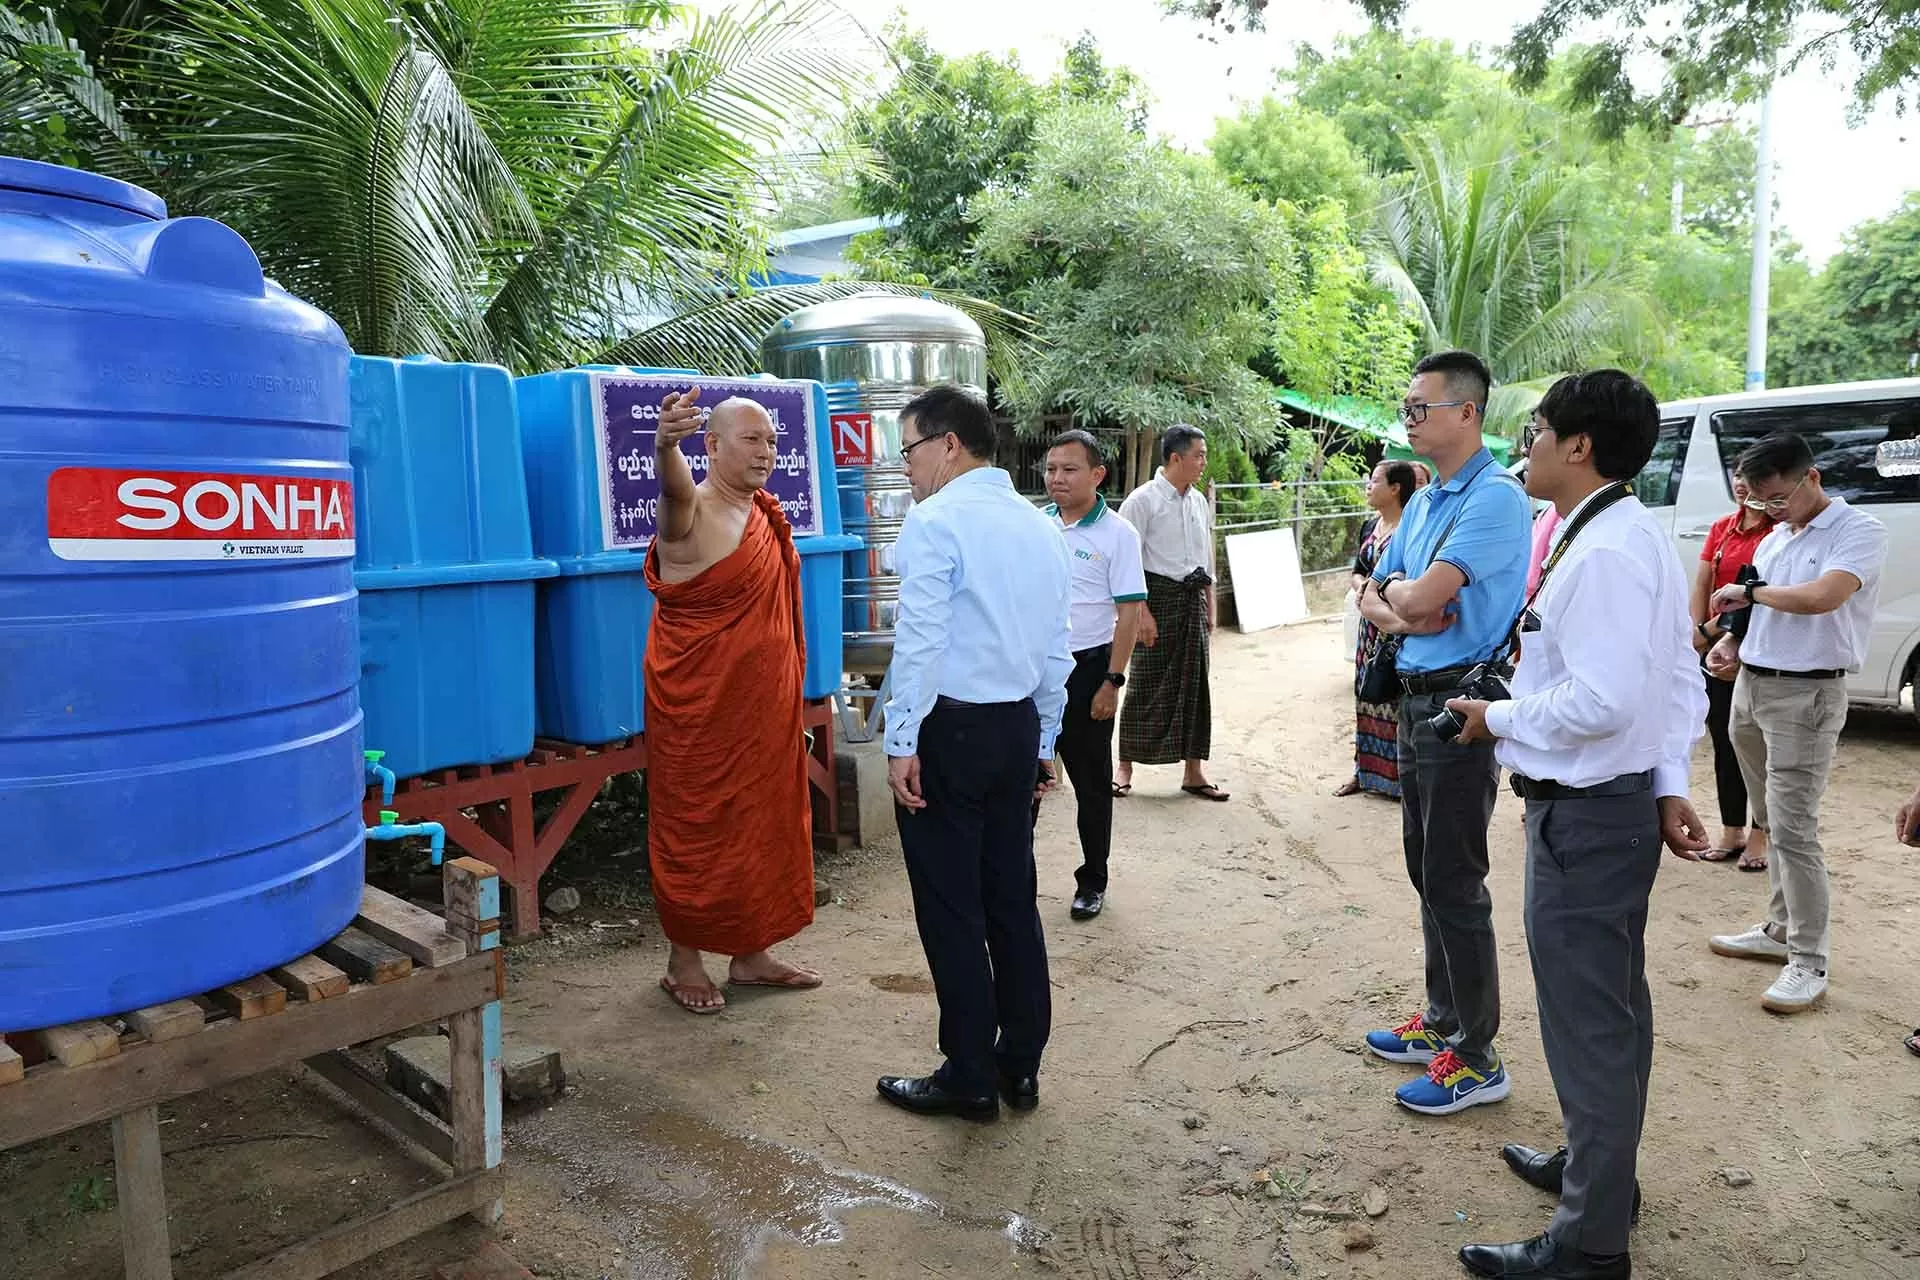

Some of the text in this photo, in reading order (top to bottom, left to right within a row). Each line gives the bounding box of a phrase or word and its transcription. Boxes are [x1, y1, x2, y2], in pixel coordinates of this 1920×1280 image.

[116, 477, 346, 531] SONHA
[239, 545, 304, 555] VIETNAM VALUE
